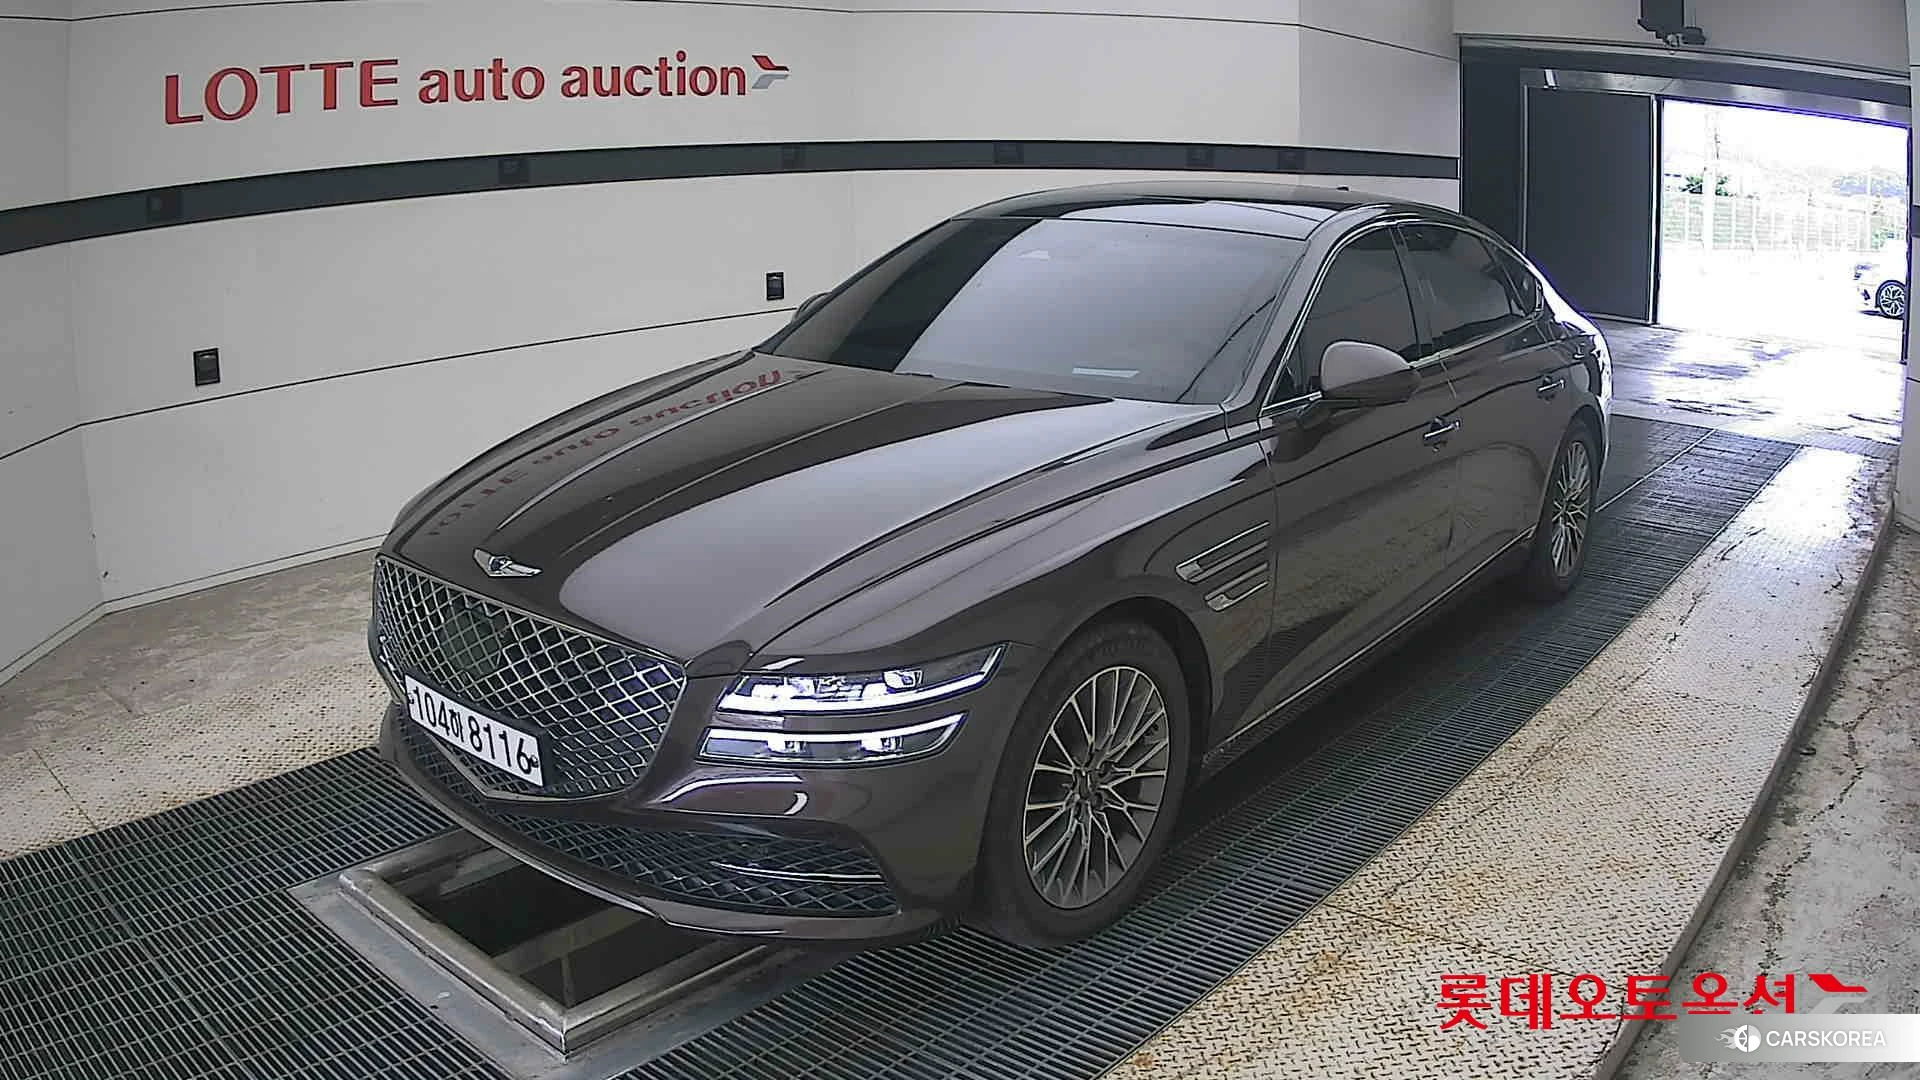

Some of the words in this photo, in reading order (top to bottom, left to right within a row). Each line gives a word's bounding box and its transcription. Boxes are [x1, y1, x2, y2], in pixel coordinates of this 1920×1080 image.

[164, 58, 399, 125] LOTTE
[418, 58, 545, 104] auto
[561, 51, 747, 97] auction
[468, 716, 532, 775] 8116
